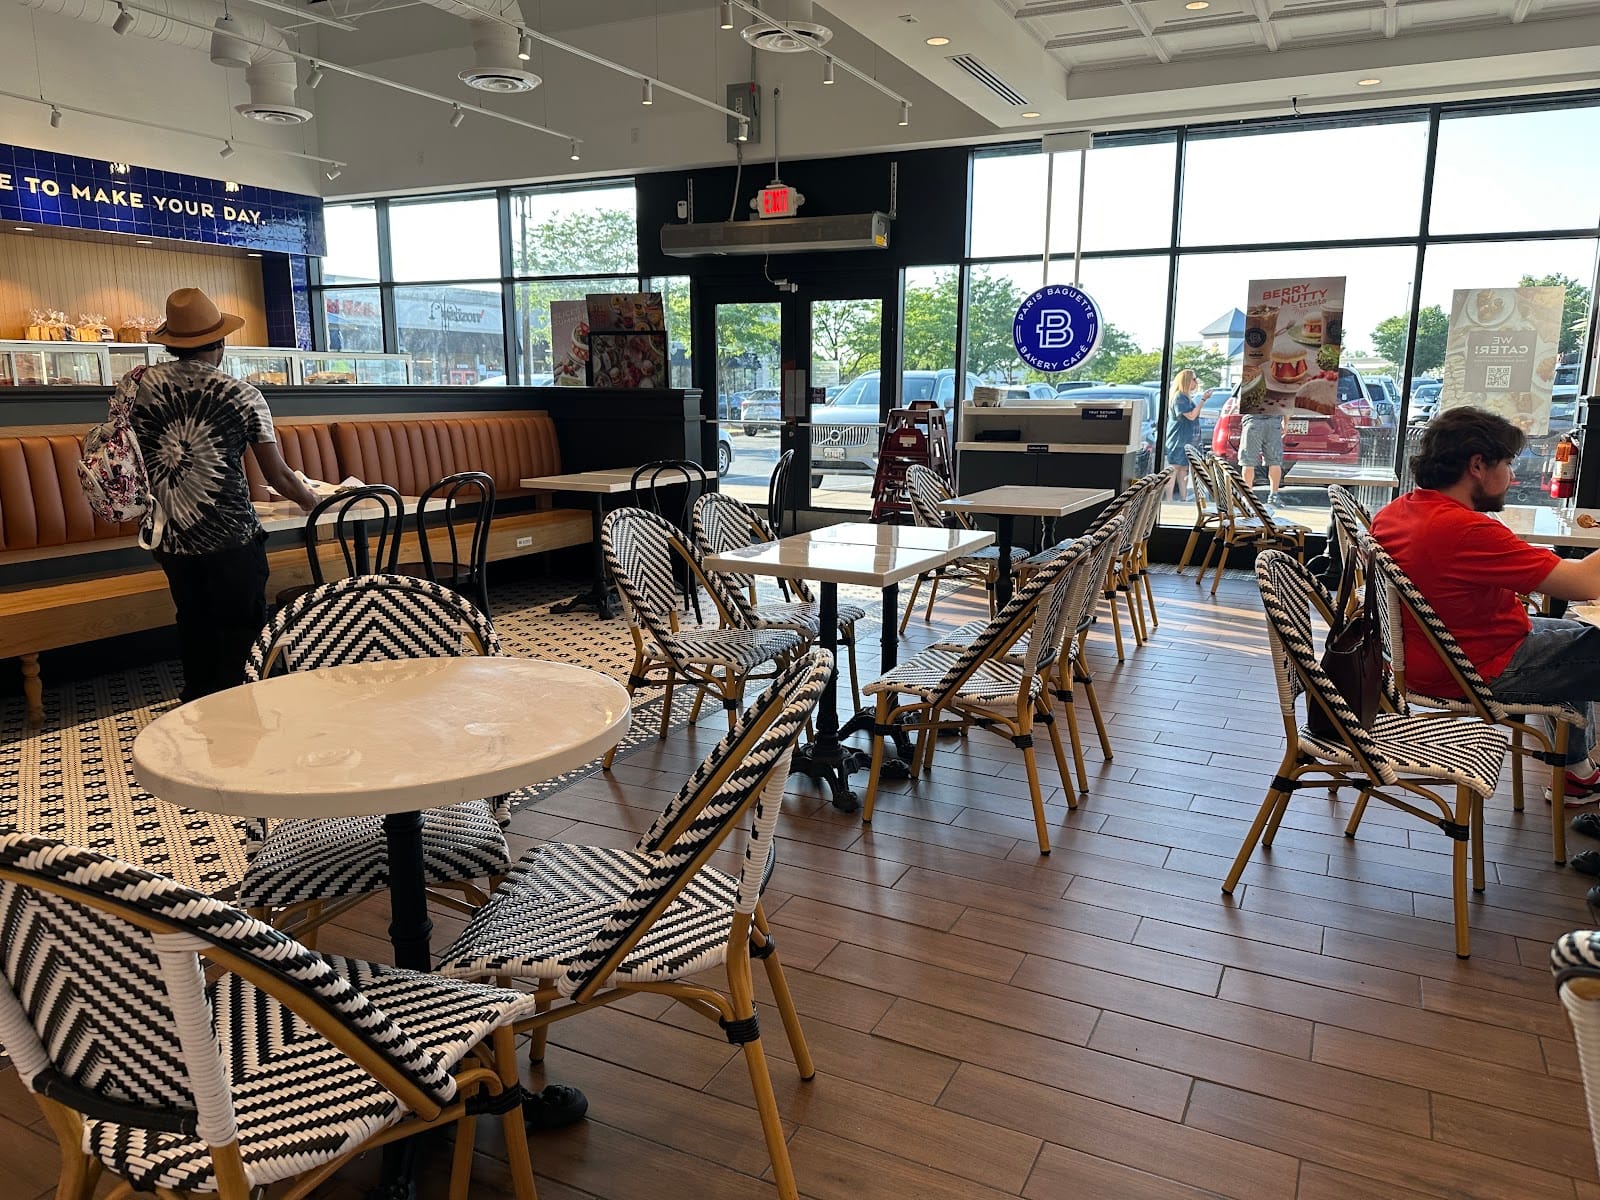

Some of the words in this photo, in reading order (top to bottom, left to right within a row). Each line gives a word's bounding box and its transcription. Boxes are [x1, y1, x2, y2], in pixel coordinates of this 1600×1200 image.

[24, 177, 60, 196] TO
[71, 184, 144, 209] MAKE
[152, 195, 215, 218] YOUR
[223, 206, 267, 226] DAY.
[764, 188, 789, 214] EXIT
[1263, 283, 1310, 300] BERRY
[1281, 288, 1328, 305] NUTTY
[1018, 292, 1043, 321] PARIS
[1047, 288, 1095, 320] BAGUETTE
[1020, 345, 1058, 370] BAKERY
